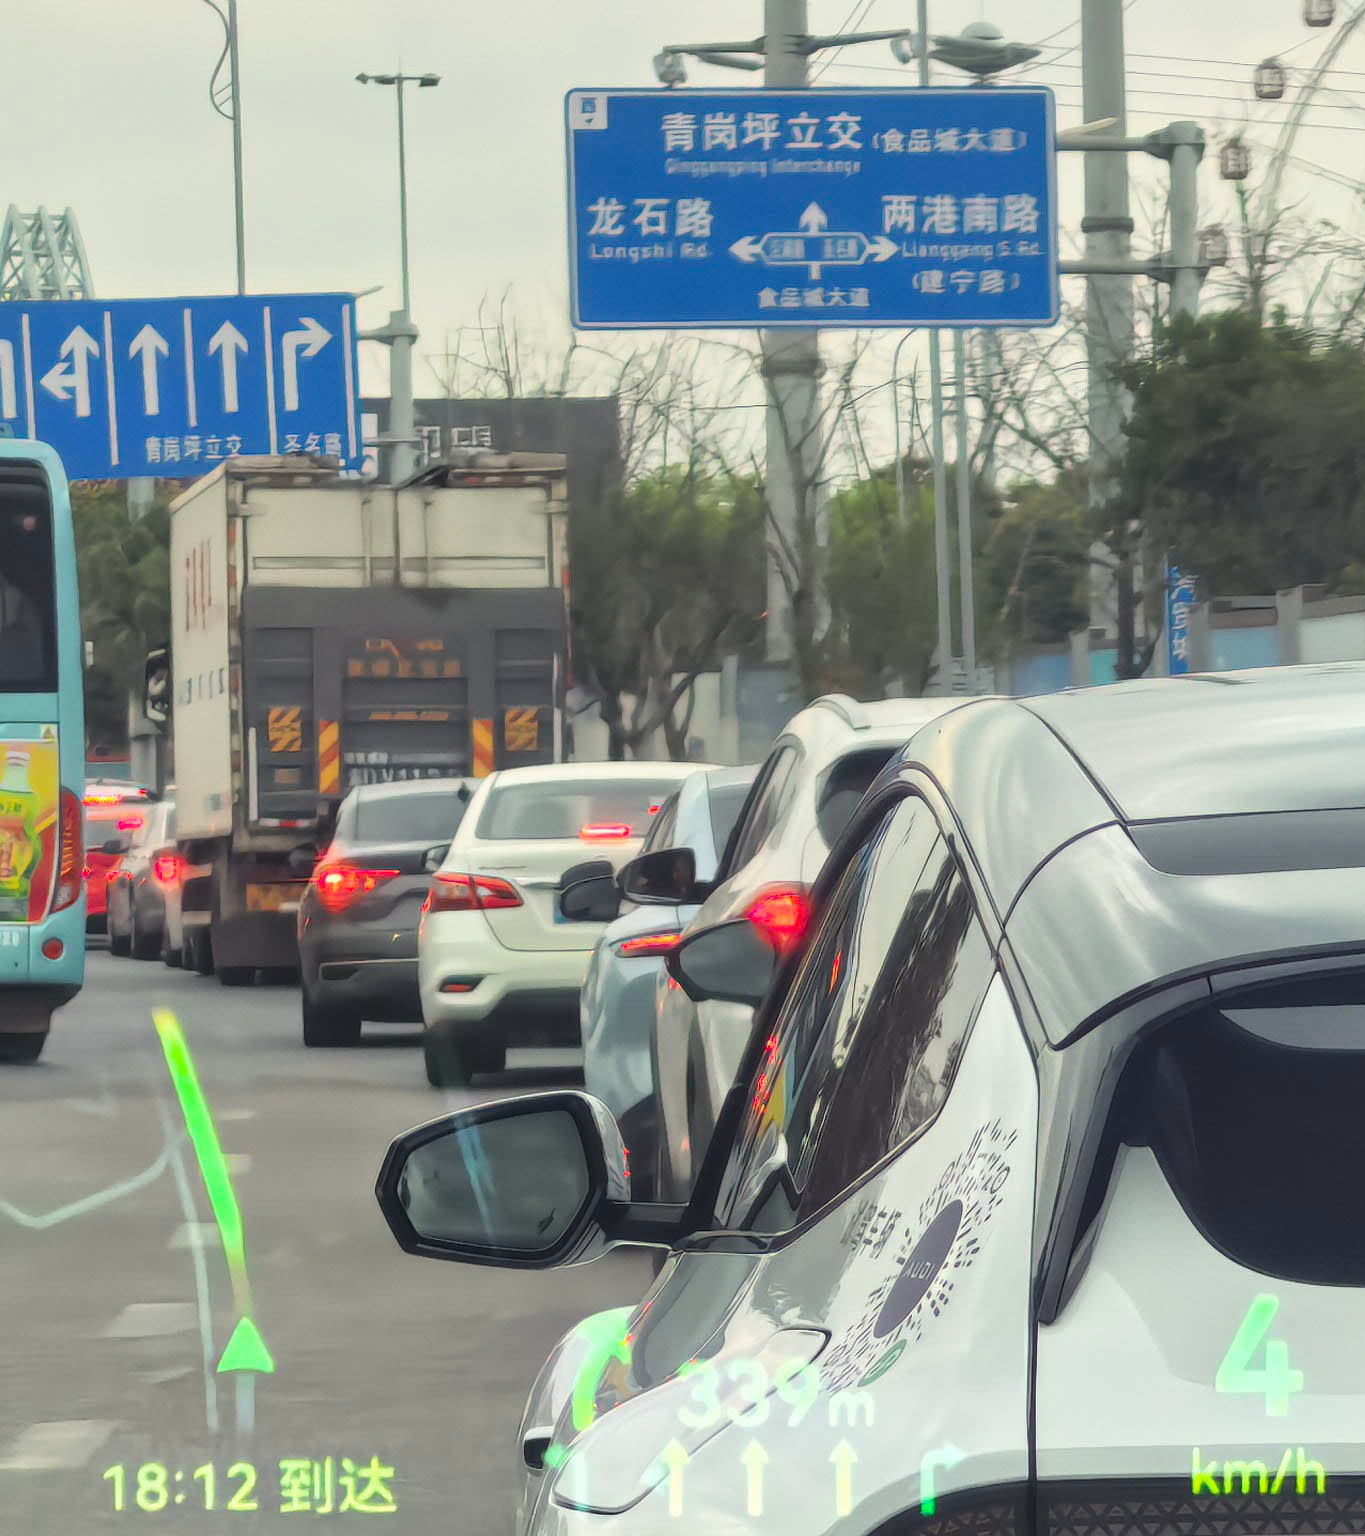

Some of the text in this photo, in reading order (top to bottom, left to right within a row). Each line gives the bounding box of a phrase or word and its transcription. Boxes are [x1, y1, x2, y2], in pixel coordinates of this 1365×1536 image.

[661, 112, 863, 152] 青岗坪立交
[587, 197, 714, 237] 龙石路
[881, 194, 1040, 235] 两港南路
[590, 243, 673, 262] Longshi
[1215, 1293, 1304, 1416] 4
[102, 1455, 398, 1513] 18:12 到达
[1192, 1447, 1326, 1494] km/h
